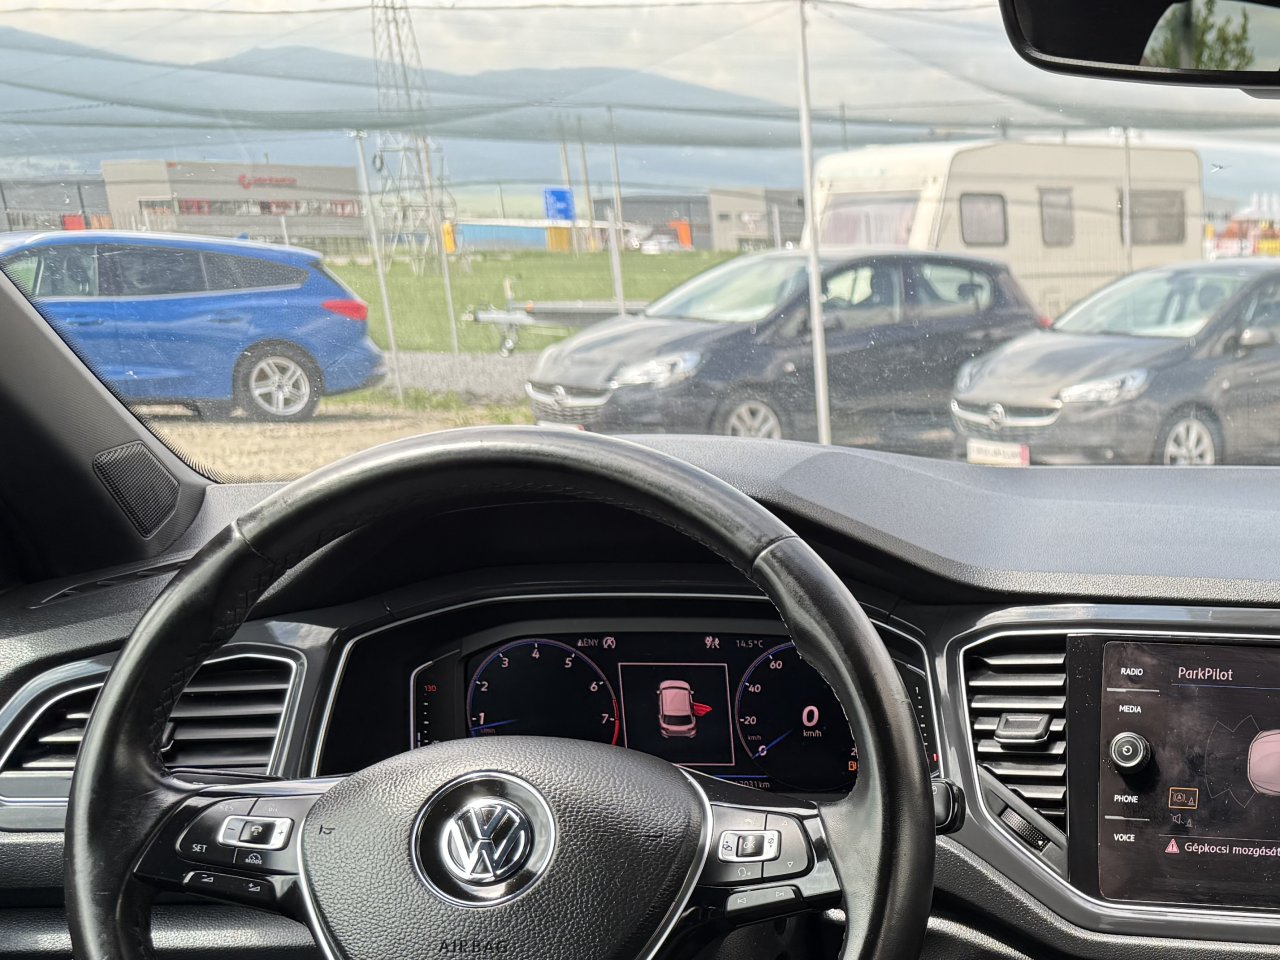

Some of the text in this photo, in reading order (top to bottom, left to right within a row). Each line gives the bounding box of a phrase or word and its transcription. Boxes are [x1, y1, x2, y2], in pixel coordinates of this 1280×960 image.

[735, 639, 764, 648] 14.5°C
[531, 649, 540, 659] 4
[501, 657, 509, 668] 3
[564, 657, 573, 668] 5
[769, 660, 783, 669] 60
[1120, 667, 1144, 676] RADIO
[1177, 666, 1234, 681] ParkPilot
[481, 681, 489, 692] 2
[590, 681, 598, 692] 6
[748, 684, 762, 693] 40
[1119, 704, 1142, 713] MEDIA
[479, 712, 485, 725] 1
[601, 713, 609, 724] 7
[743, 716, 757, 725] 20
[801, 705, 820, 727] 0
[802, 728, 822, 738] km/h
[1114, 794, 1139, 803] PHONE
[1113, 833, 1136, 842] VOICE
[192, 843, 208, 853] SET
[743, 841, 756, 849] OK
[1184, 842, 1230, 856] Gépkocsi
[1232, 845, 1280, 857] mozgását
[438, 939, 509, 953] AIRBAG
